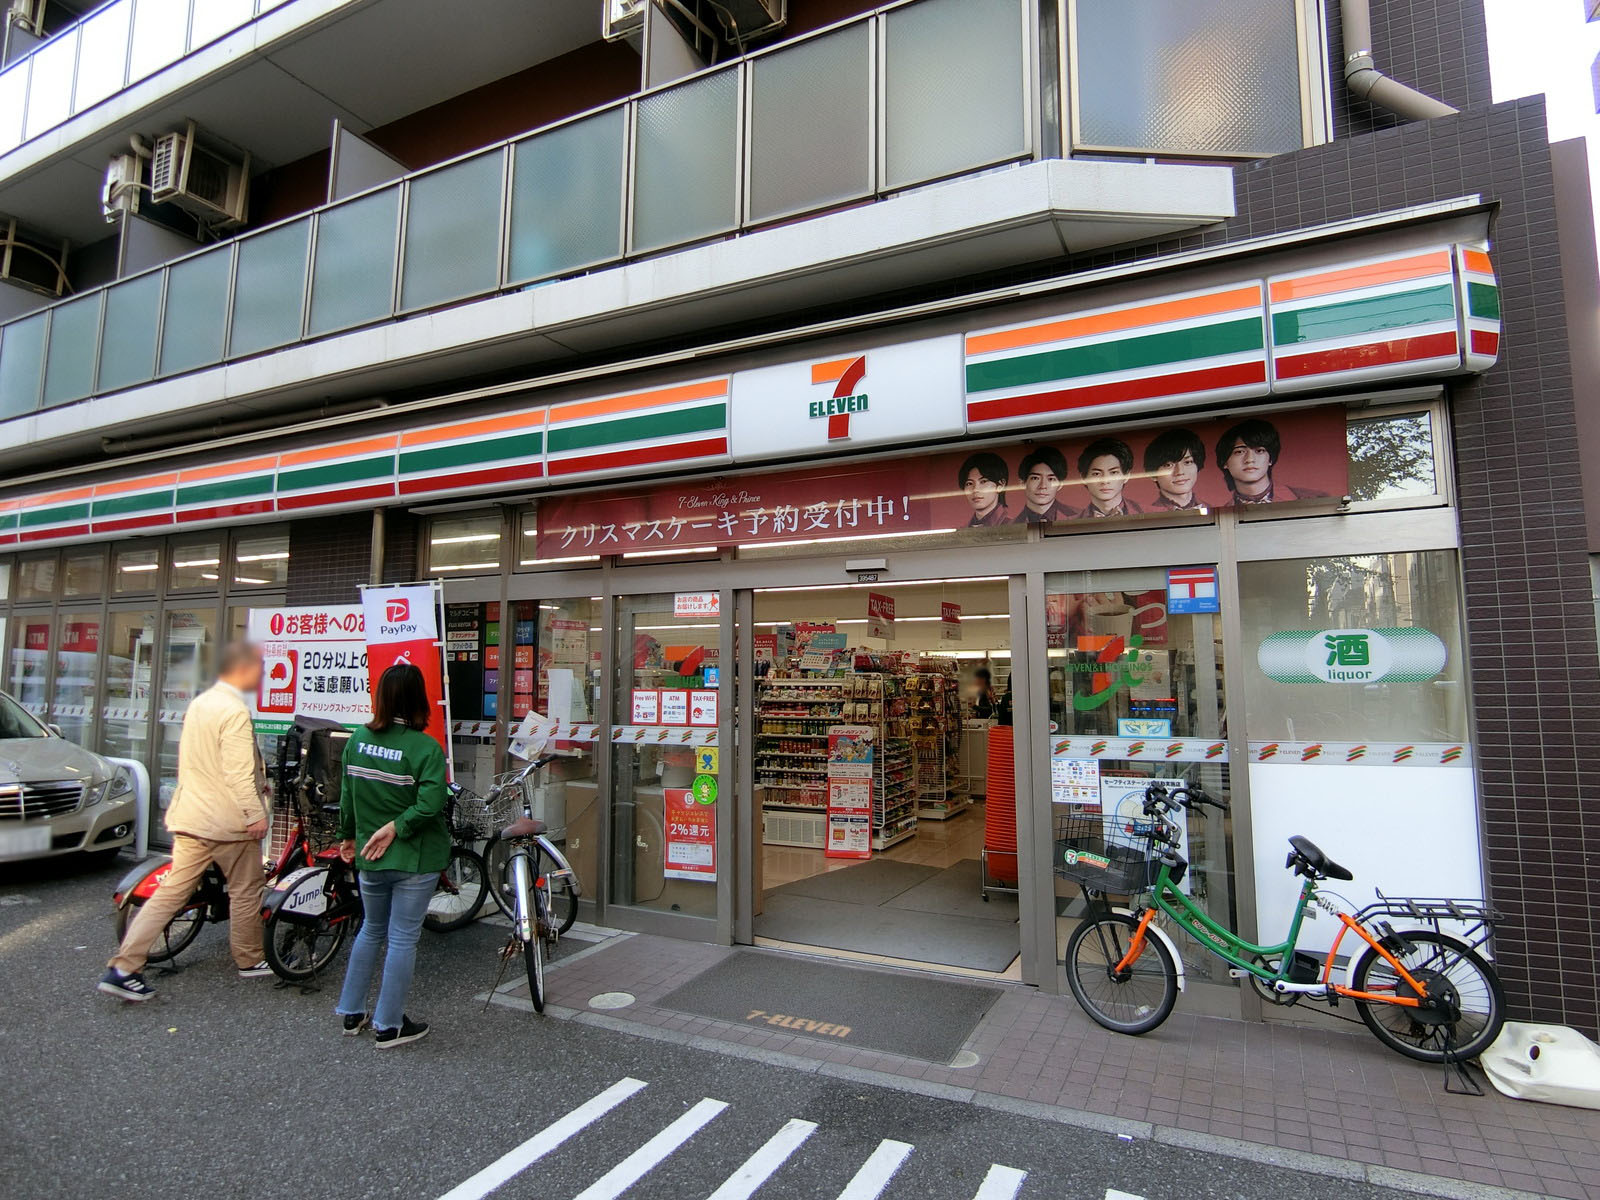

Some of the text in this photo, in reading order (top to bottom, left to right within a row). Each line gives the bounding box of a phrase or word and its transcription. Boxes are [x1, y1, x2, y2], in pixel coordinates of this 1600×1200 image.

[870, 599, 894, 615] TAX-FREE
[380, 624, 417, 635] PayPay
[1324, 633, 1370, 667] 酒
[1327, 669, 1372, 681] liquor
[670, 823, 710, 837] 2%還元
[289, 885, 322, 909] Jump!
